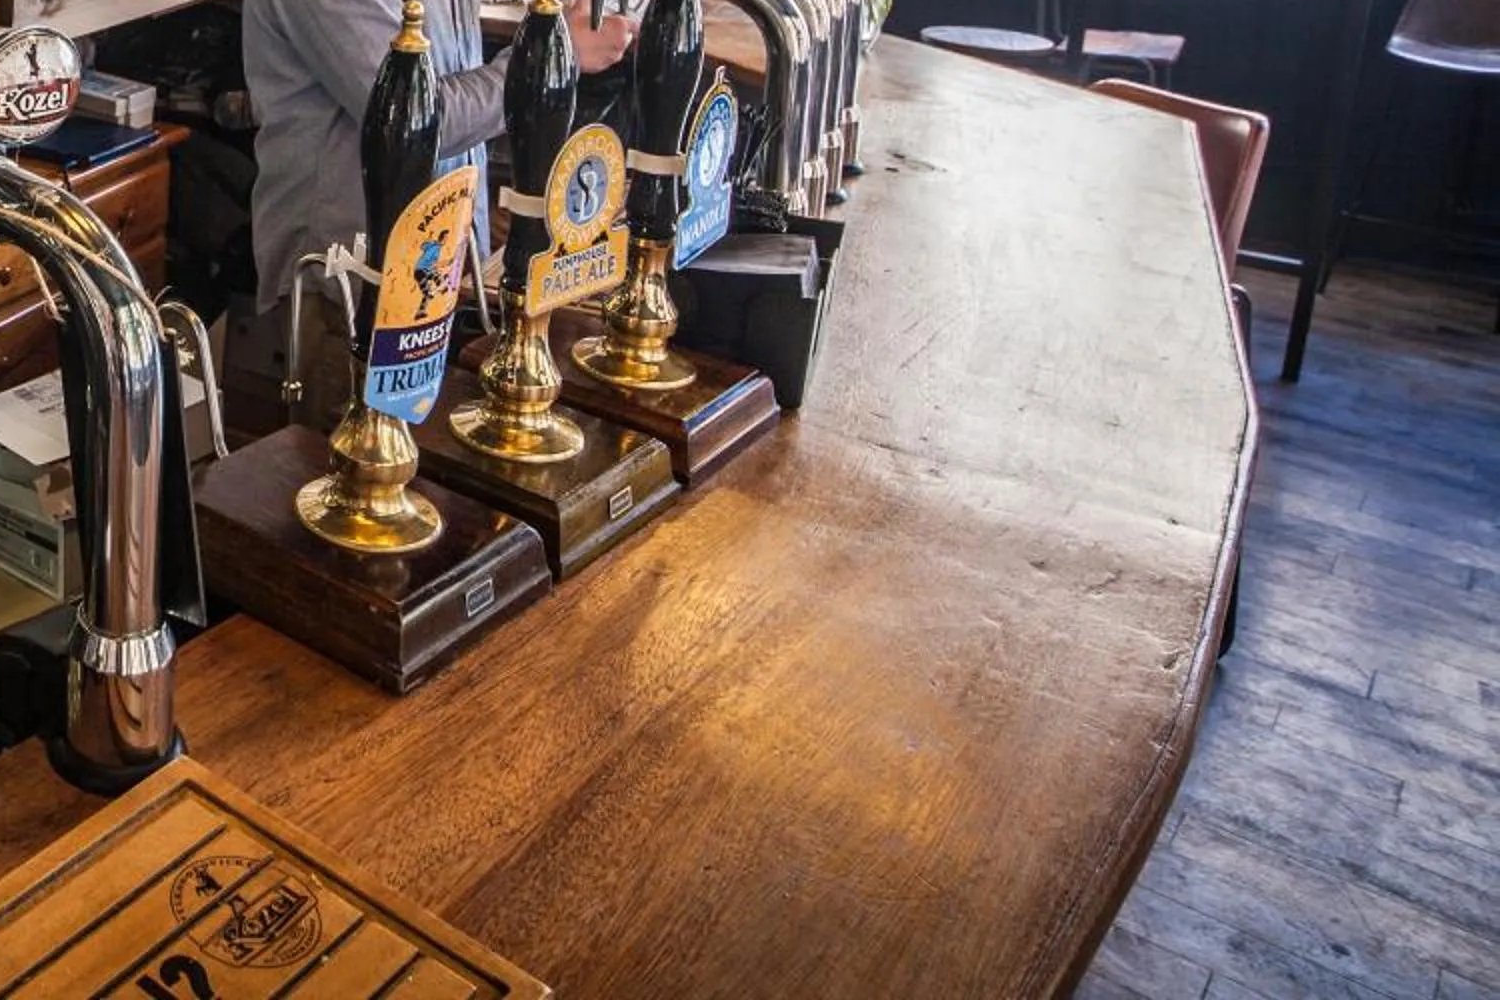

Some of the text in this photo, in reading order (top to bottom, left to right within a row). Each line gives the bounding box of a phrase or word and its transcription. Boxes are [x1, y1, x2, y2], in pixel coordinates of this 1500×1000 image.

[417, 191, 456, 232] PACIFIC
[543, 255, 616, 297] PALE ALE
[553, 244, 607, 272] PUMPHOUSE
[398, 322, 445, 351] KNEES
[373, 353, 444, 394] TRUMA
[223, 884, 309, 961] Kozel
